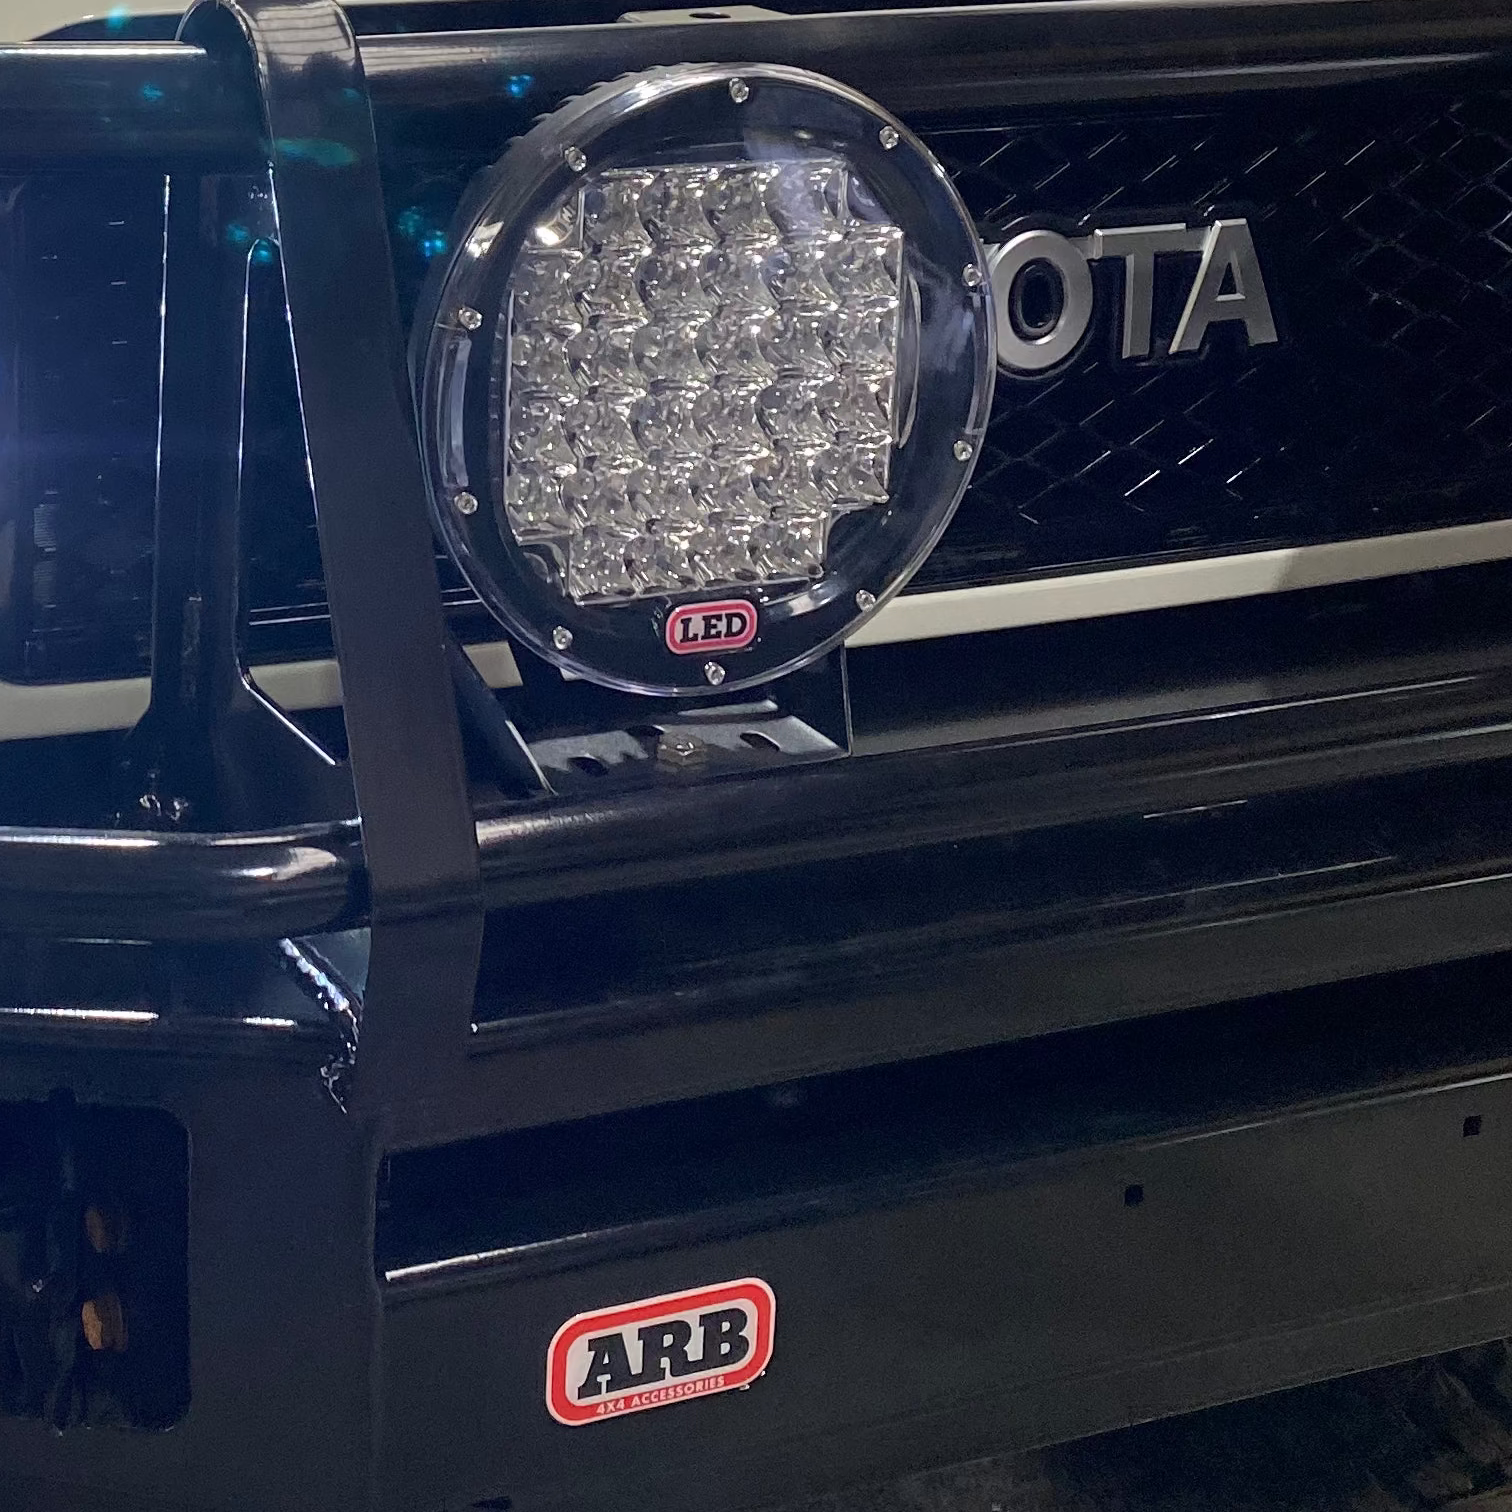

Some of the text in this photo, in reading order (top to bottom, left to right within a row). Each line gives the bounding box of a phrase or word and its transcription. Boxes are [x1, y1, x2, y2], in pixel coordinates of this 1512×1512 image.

[984, 218, 1278, 369] OTA
[680, 613, 747, 643] LED
[577, 1308, 749, 1400] ARB
[596, 1376, 725, 1415] 4X4 ACCESSORIES
